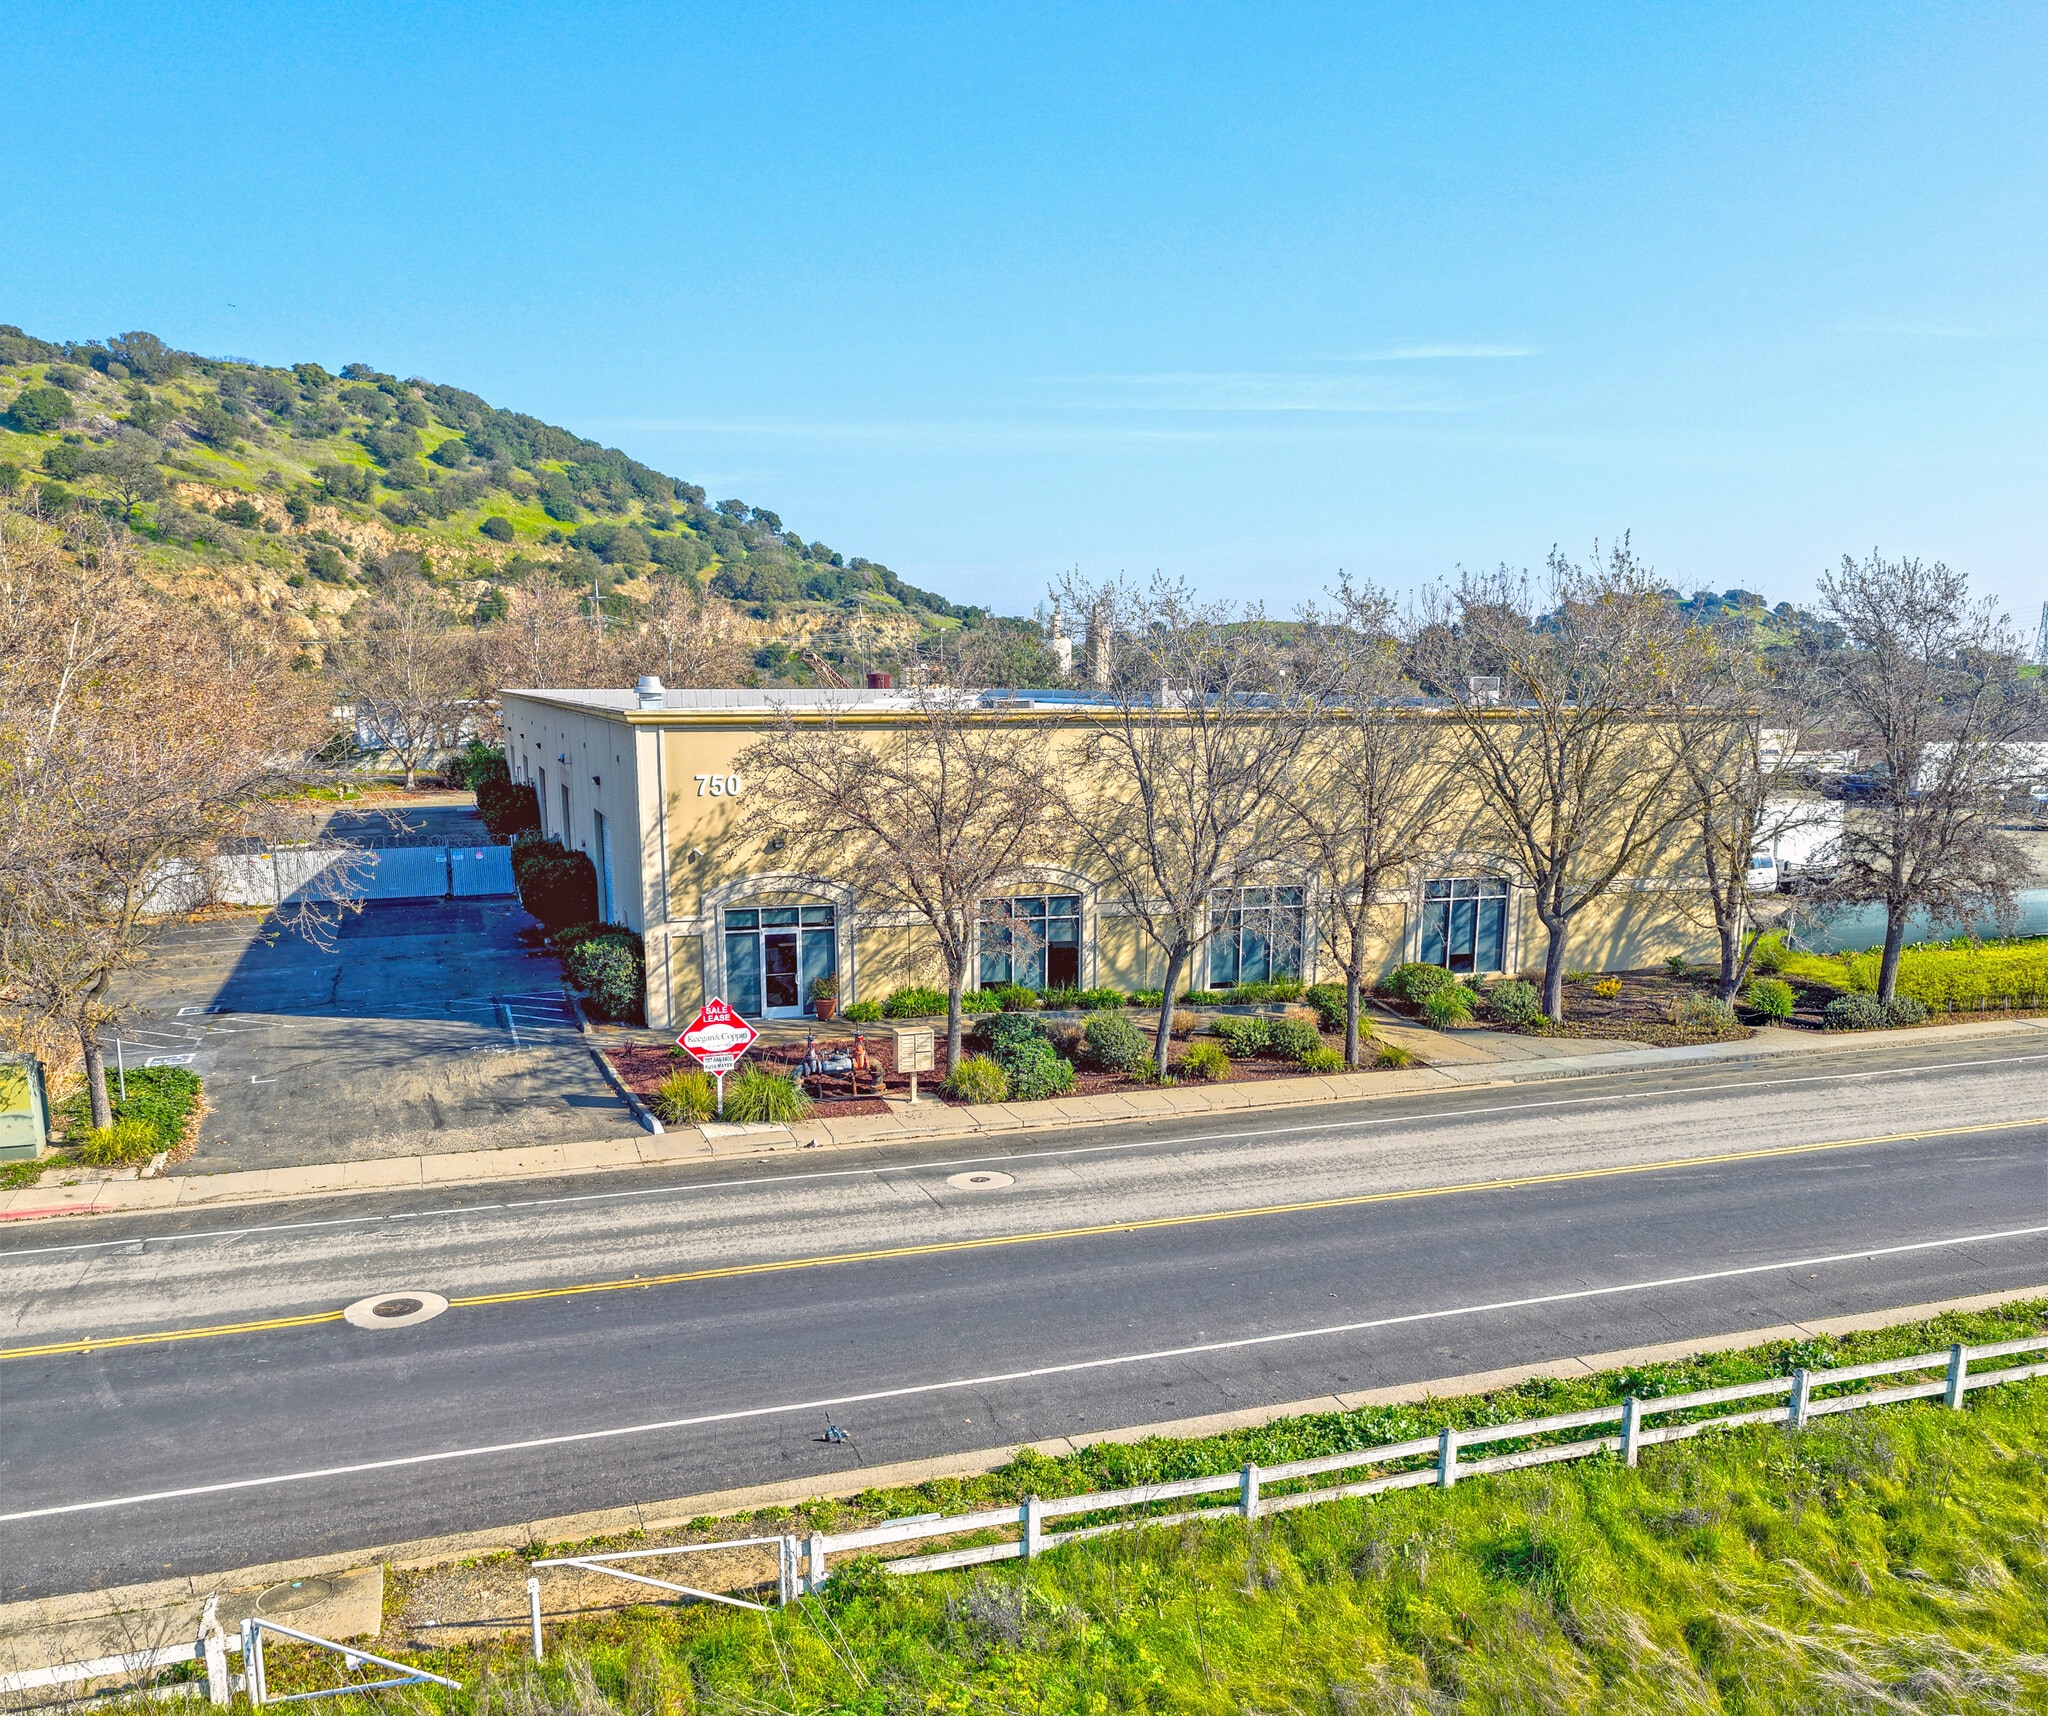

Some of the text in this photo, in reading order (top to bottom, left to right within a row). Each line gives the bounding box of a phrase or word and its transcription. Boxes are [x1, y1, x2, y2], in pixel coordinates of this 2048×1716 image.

[694, 774, 740, 797] 750
[705, 1006, 728, 1014] SALE
[703, 1014, 730, 1022] LEASE
